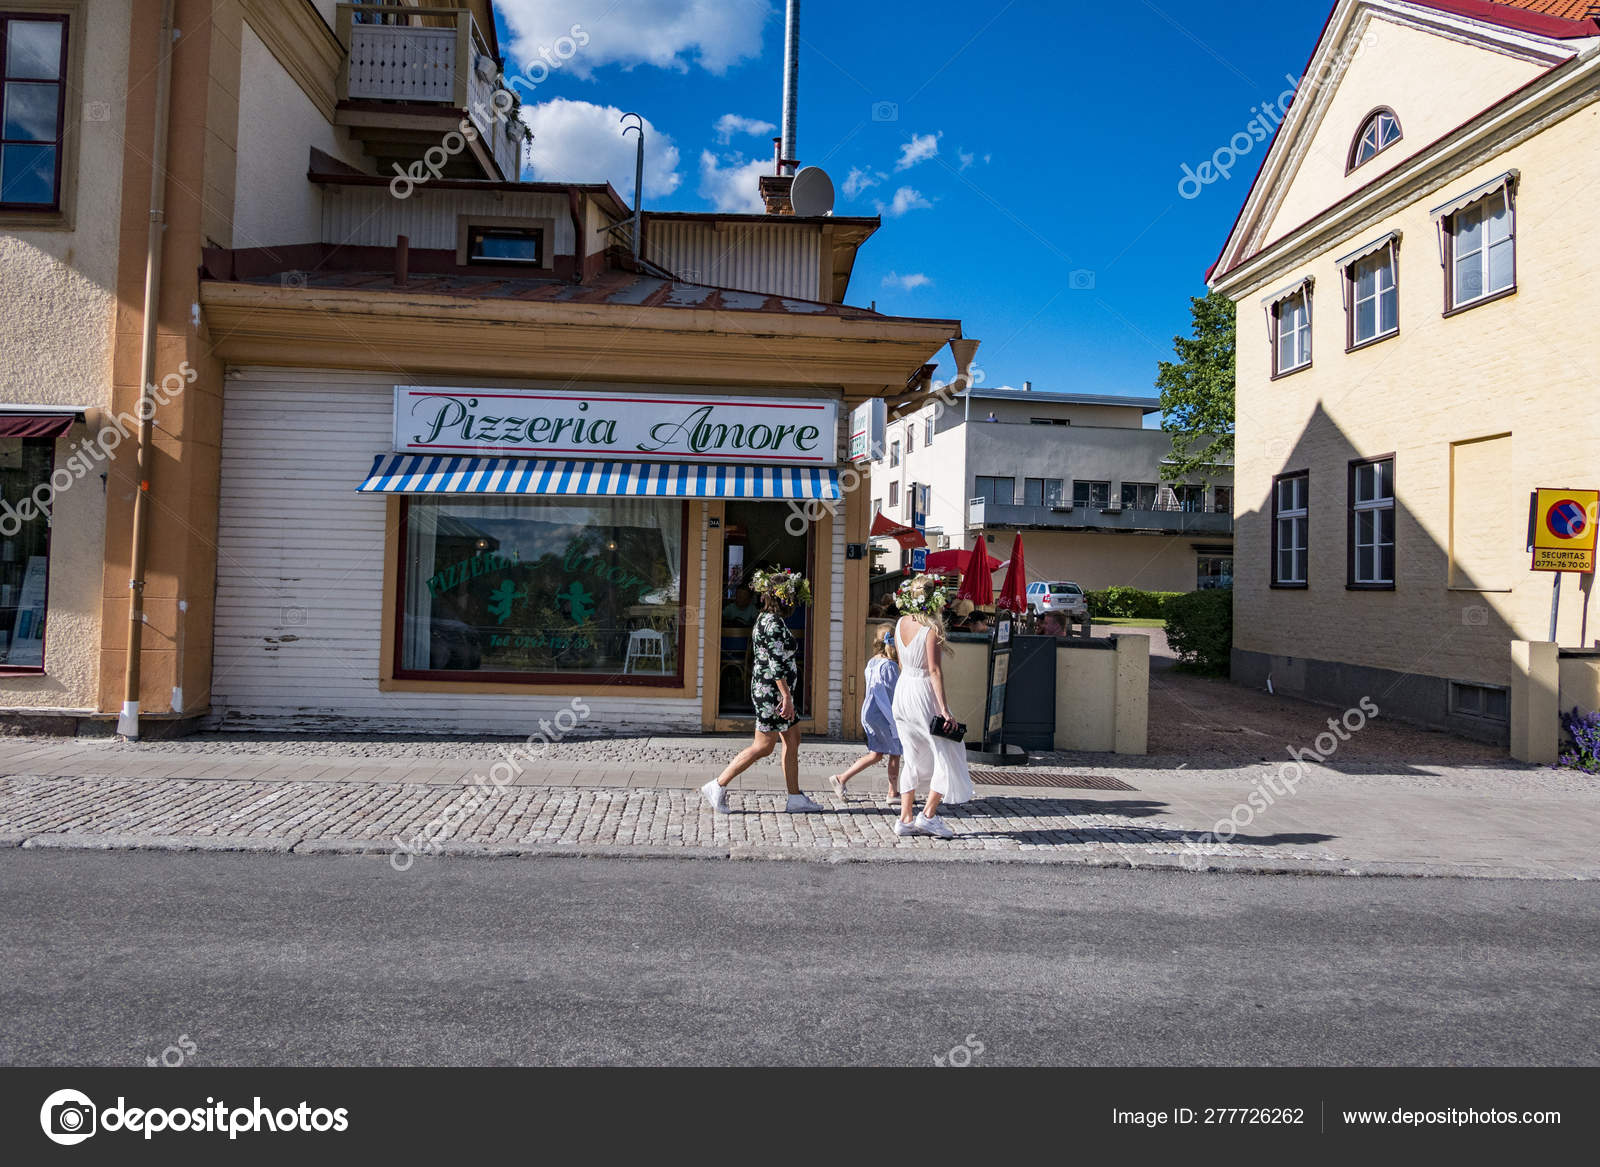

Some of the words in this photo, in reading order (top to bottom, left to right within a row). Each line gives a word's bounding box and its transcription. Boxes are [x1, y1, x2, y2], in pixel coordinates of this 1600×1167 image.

[412, 396, 617, 443] Pizzeria
[635, 406, 819, 453] Amore
[1541, 551, 1585, 560] SECURITAS
